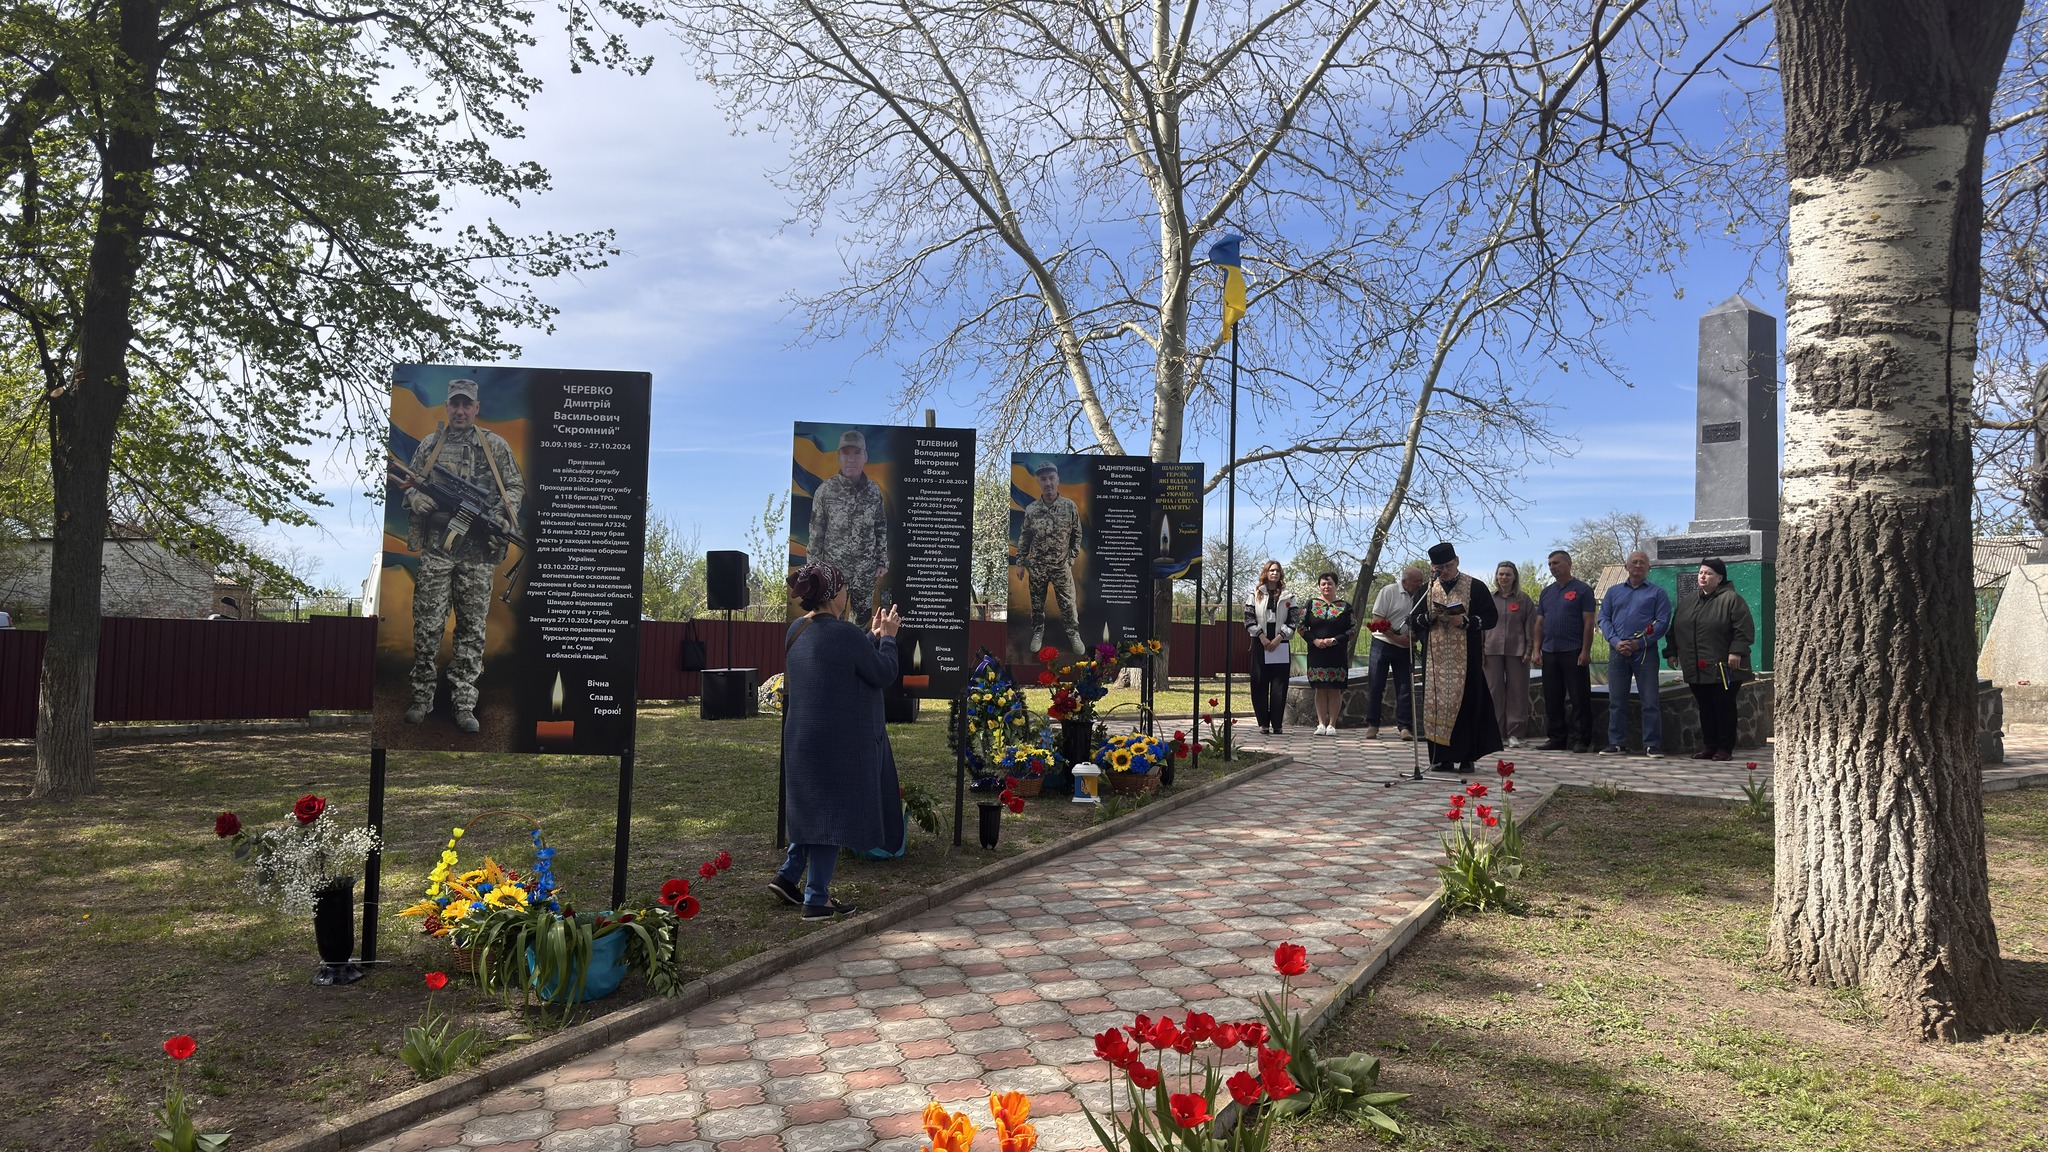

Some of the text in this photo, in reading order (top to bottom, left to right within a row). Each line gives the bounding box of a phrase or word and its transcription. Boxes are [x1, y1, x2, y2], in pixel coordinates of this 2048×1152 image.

[563, 385, 613, 395] ЧЕРЕВКО
[563, 398, 611, 410] Дмитрій
[554, 411, 620, 422] Васильович
[553, 424, 620, 435] "Скромний"
[914, 449, 960, 458] Володимир
[914, 459, 959, 467] Вікторович
[574, 485, 606, 493] військову
[607, 486, 631, 494] службу
[552, 502, 617, 510] Розвідник-навідник
[551, 511, 607, 519] розвідувального
[594, 707, 621, 716] Герою!
